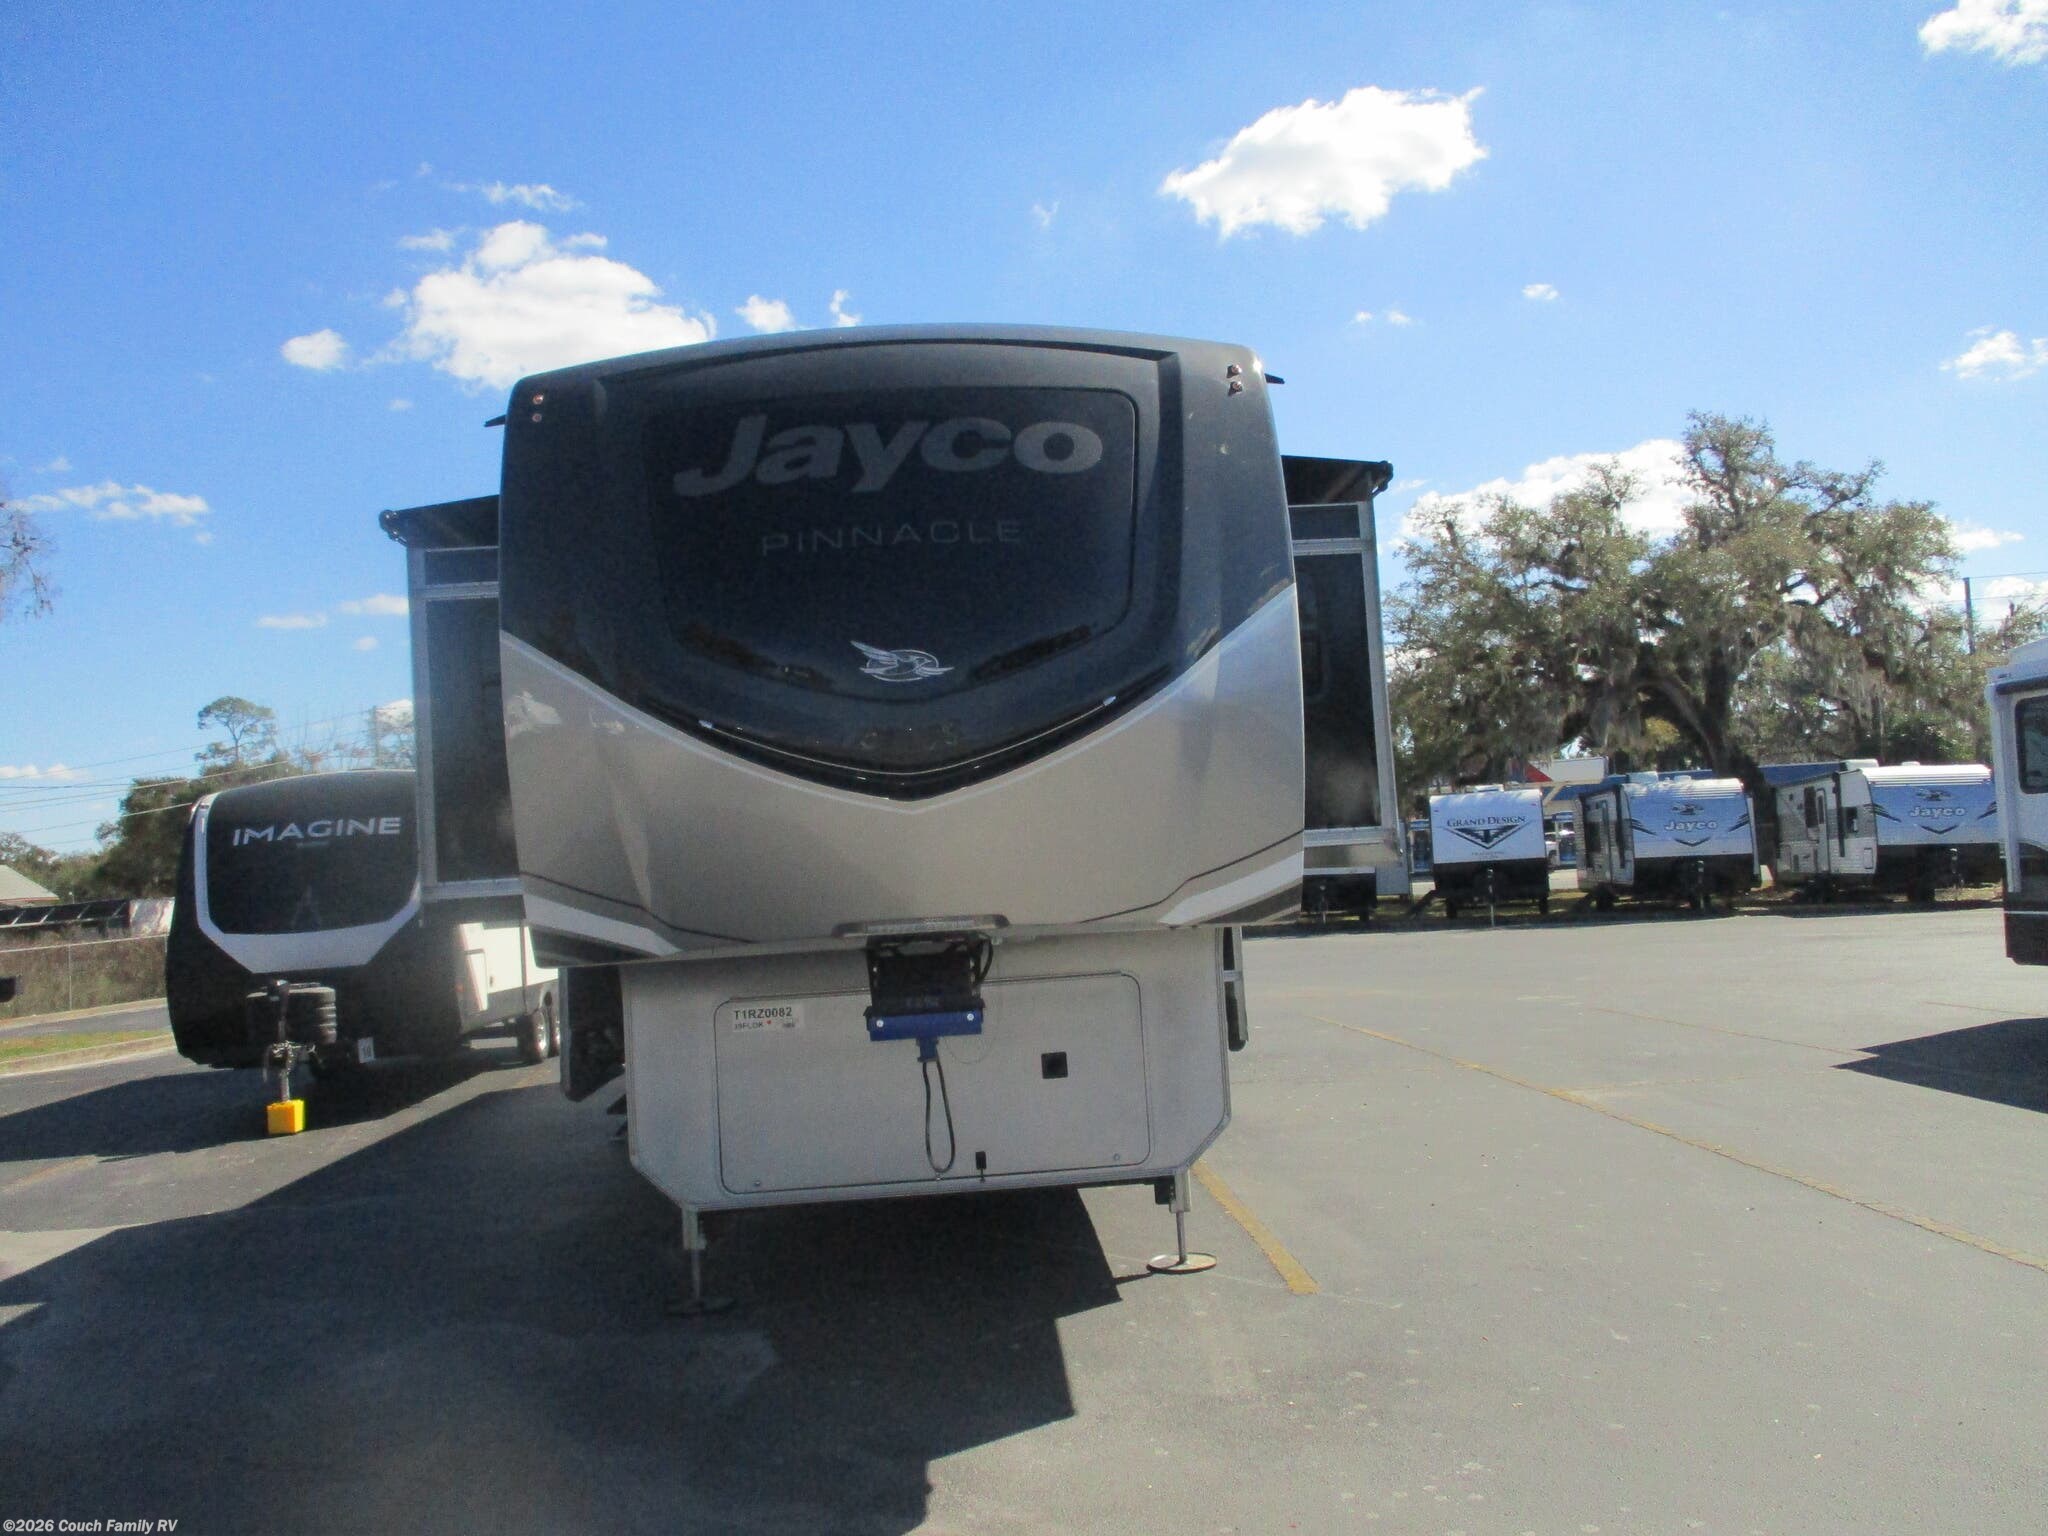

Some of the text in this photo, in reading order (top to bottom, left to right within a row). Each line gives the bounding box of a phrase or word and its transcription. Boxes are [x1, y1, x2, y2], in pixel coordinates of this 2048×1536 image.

[672, 413, 1104, 497] Jayco
[761, 519, 1022, 556] PINNACLE
[1909, 806, 1966, 819] Jayco
[1446, 815, 1526, 828] GRAND DESIGN
[1664, 820, 1718, 832] Jayco
[232, 816, 402, 847] IMAGINE
[734, 1006, 793, 1020] T1RZ0082
